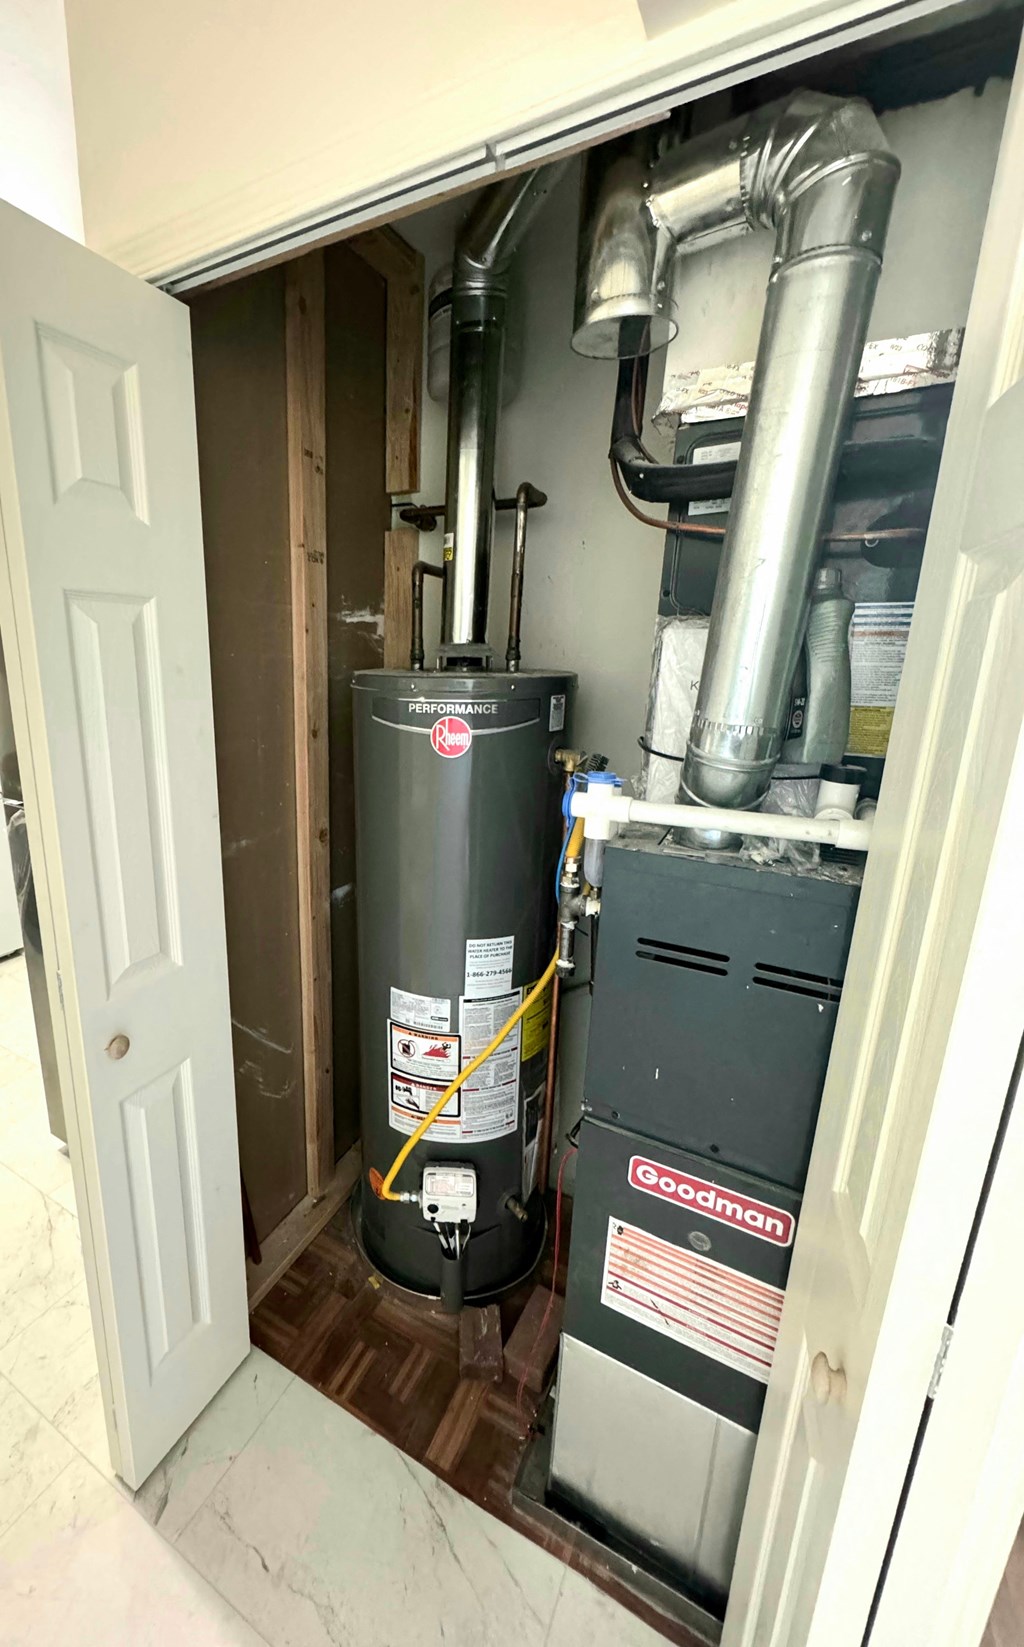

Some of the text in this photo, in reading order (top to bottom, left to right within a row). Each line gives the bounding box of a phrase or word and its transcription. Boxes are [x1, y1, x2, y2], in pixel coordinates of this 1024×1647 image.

[408, 702, 499, 715] PERFORMANCE
[435, 719, 469, 751] Rheem
[413, 1032, 439, 1041] WARNING
[636, 1164, 784, 1236] Goodman
